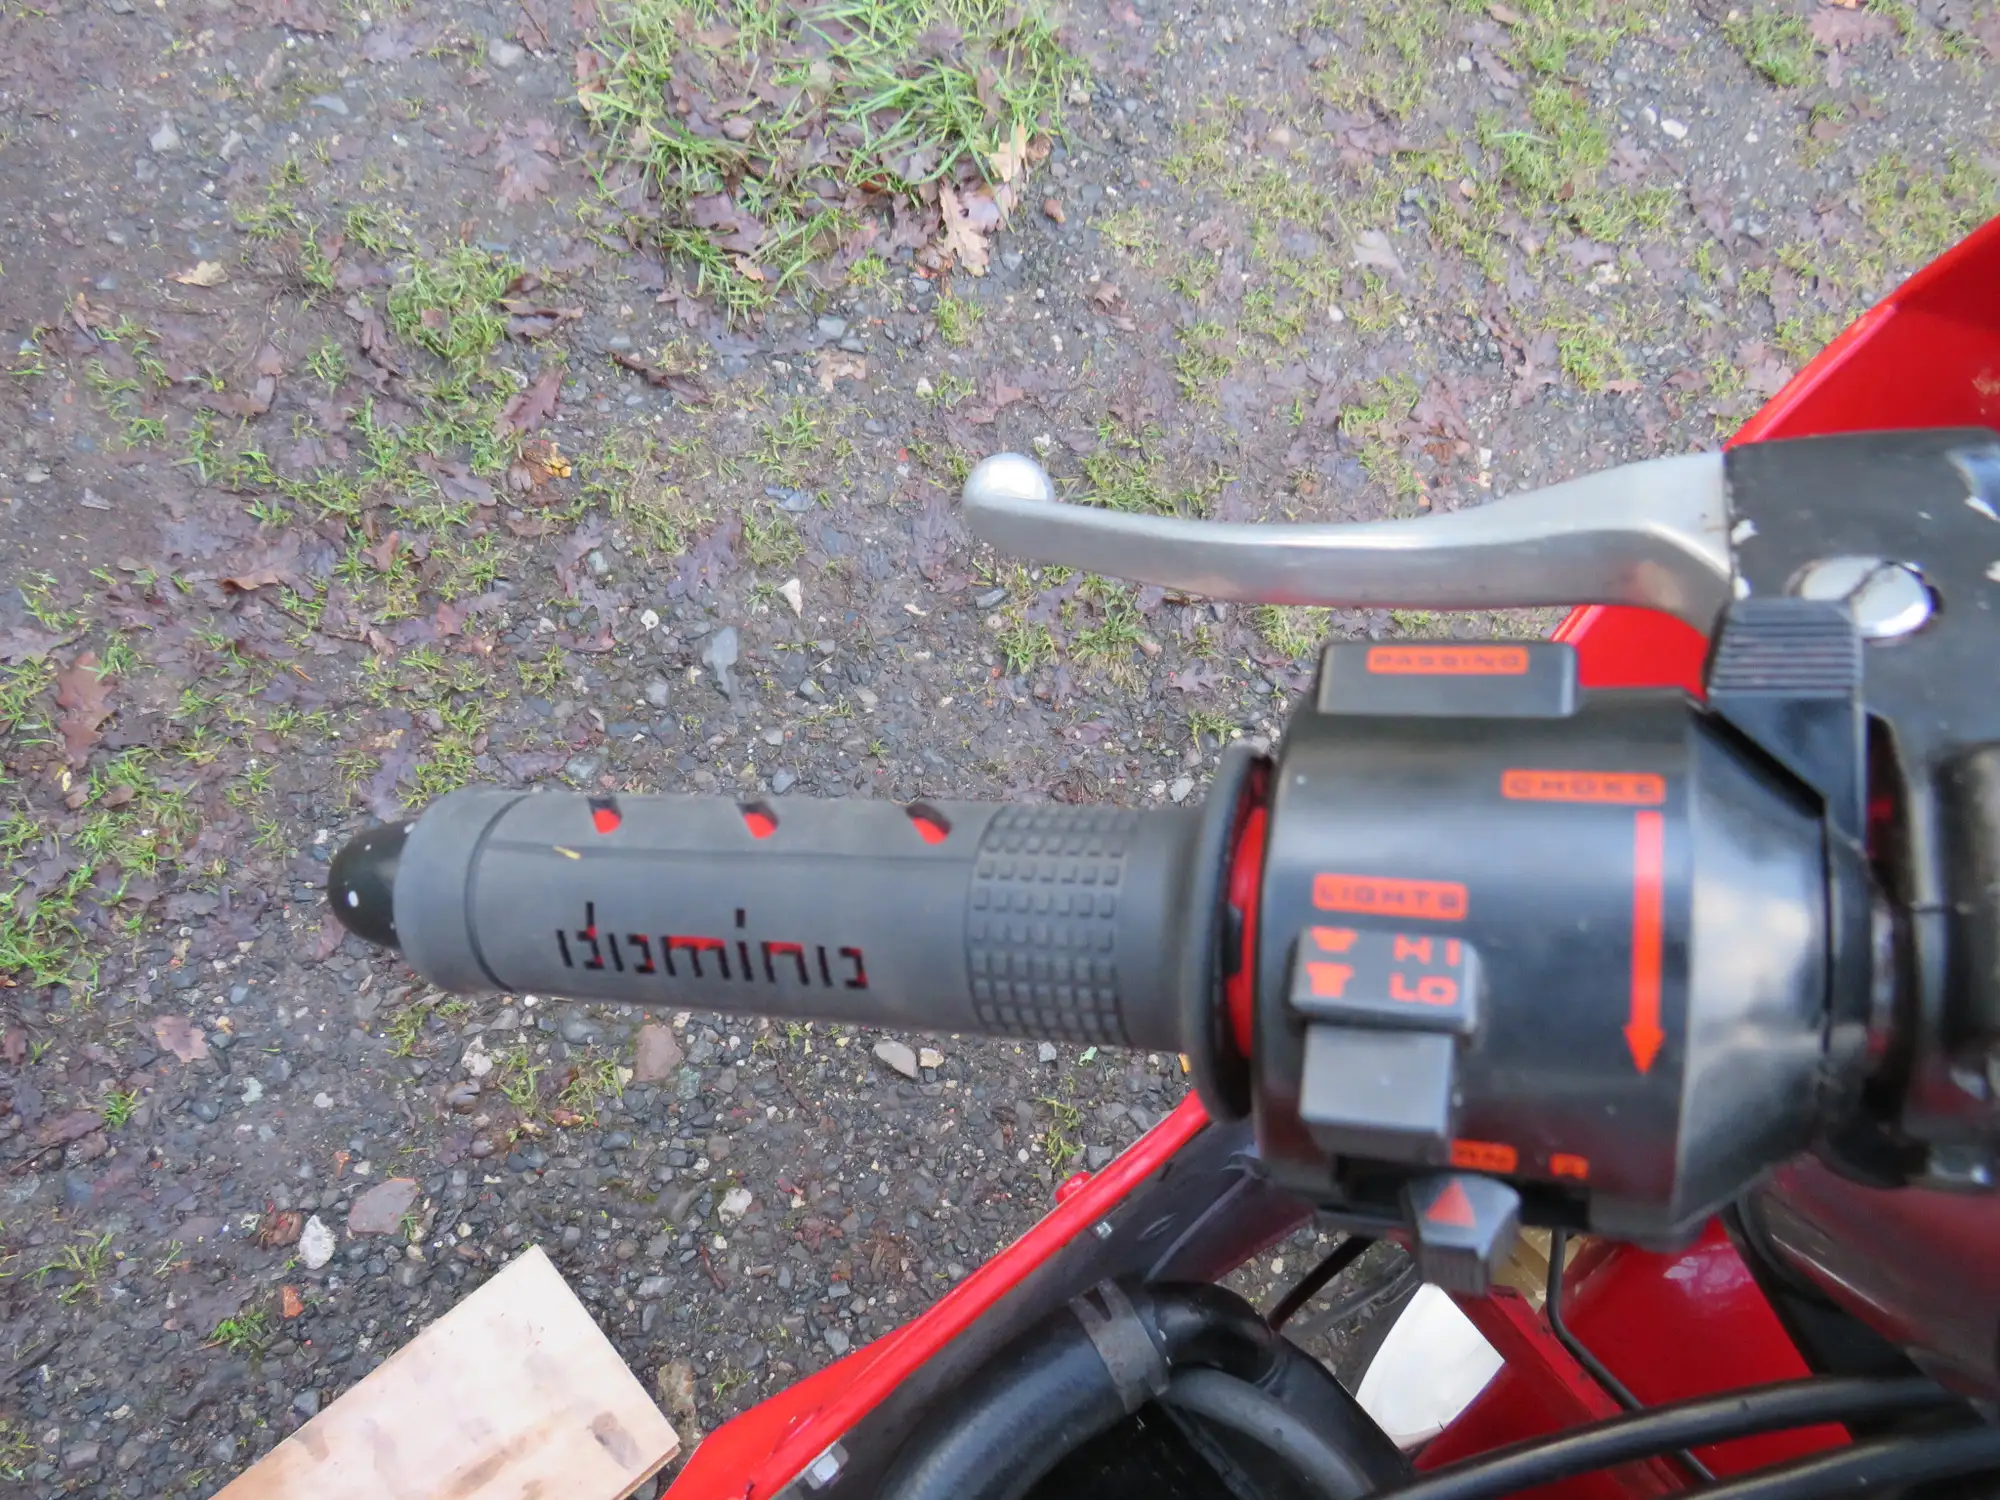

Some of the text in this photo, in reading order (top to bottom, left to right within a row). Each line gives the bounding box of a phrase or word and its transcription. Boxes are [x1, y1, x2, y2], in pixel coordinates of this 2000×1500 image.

[1506, 774, 1659, 799] CHOKE
[1316, 880, 1462, 914] LIGHTS
[555, 900, 869, 989] domino
[1393, 933, 1461, 967] HI
[1389, 971, 1459, 1006] LO
